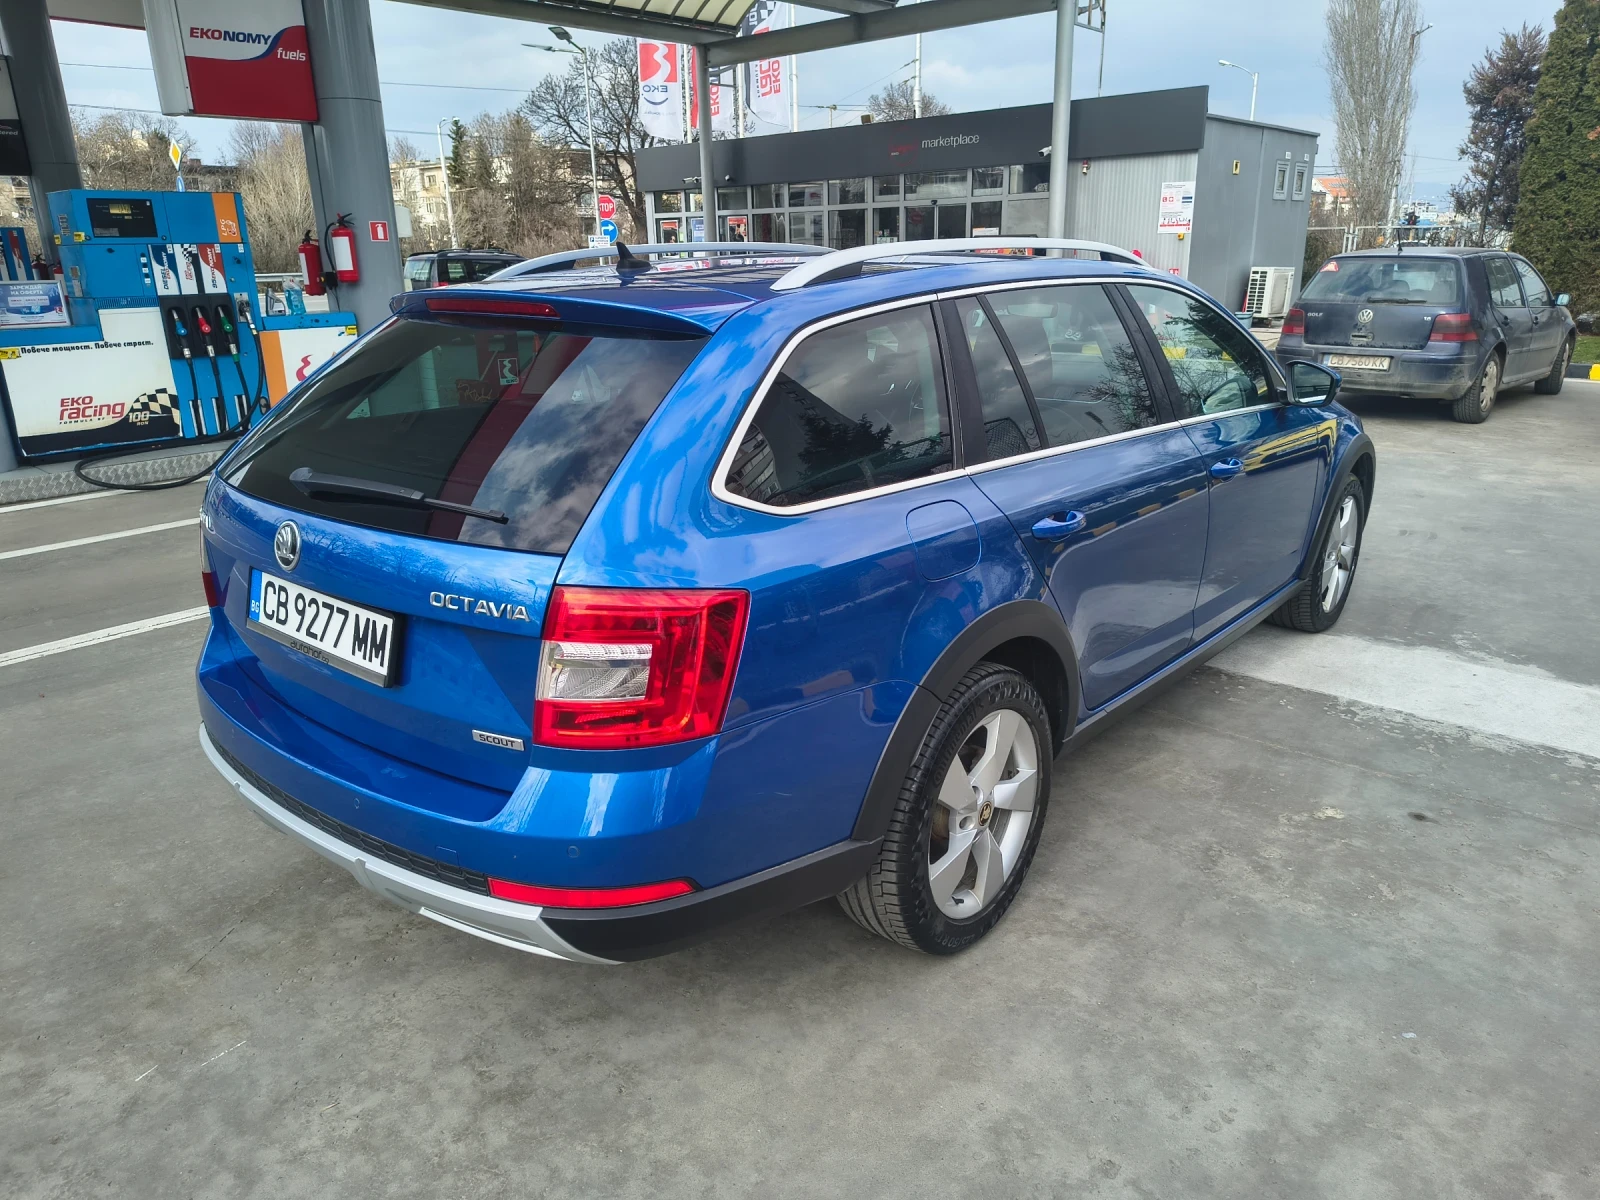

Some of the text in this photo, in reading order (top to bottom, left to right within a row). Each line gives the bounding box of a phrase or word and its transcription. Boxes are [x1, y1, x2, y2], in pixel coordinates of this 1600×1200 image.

[189, 26, 272, 45] EKONOMY
[277, 47, 306, 62] fuels
[921, 133, 980, 149] marketplace
[220, 218, 228, 236] LPG
[20, 346, 50, 354] Повече
[52, 343, 93, 352] мощност.
[94, 341, 122, 349] Повече
[123, 339, 154, 348] страст.
[60, 395, 94, 408] EKO
[59, 402, 126, 420] racing
[429, 591, 531, 622] OCTAVIA
[251, 580, 388, 667] BG CB 9277 MM
[479, 734, 516, 748] SCOUT
